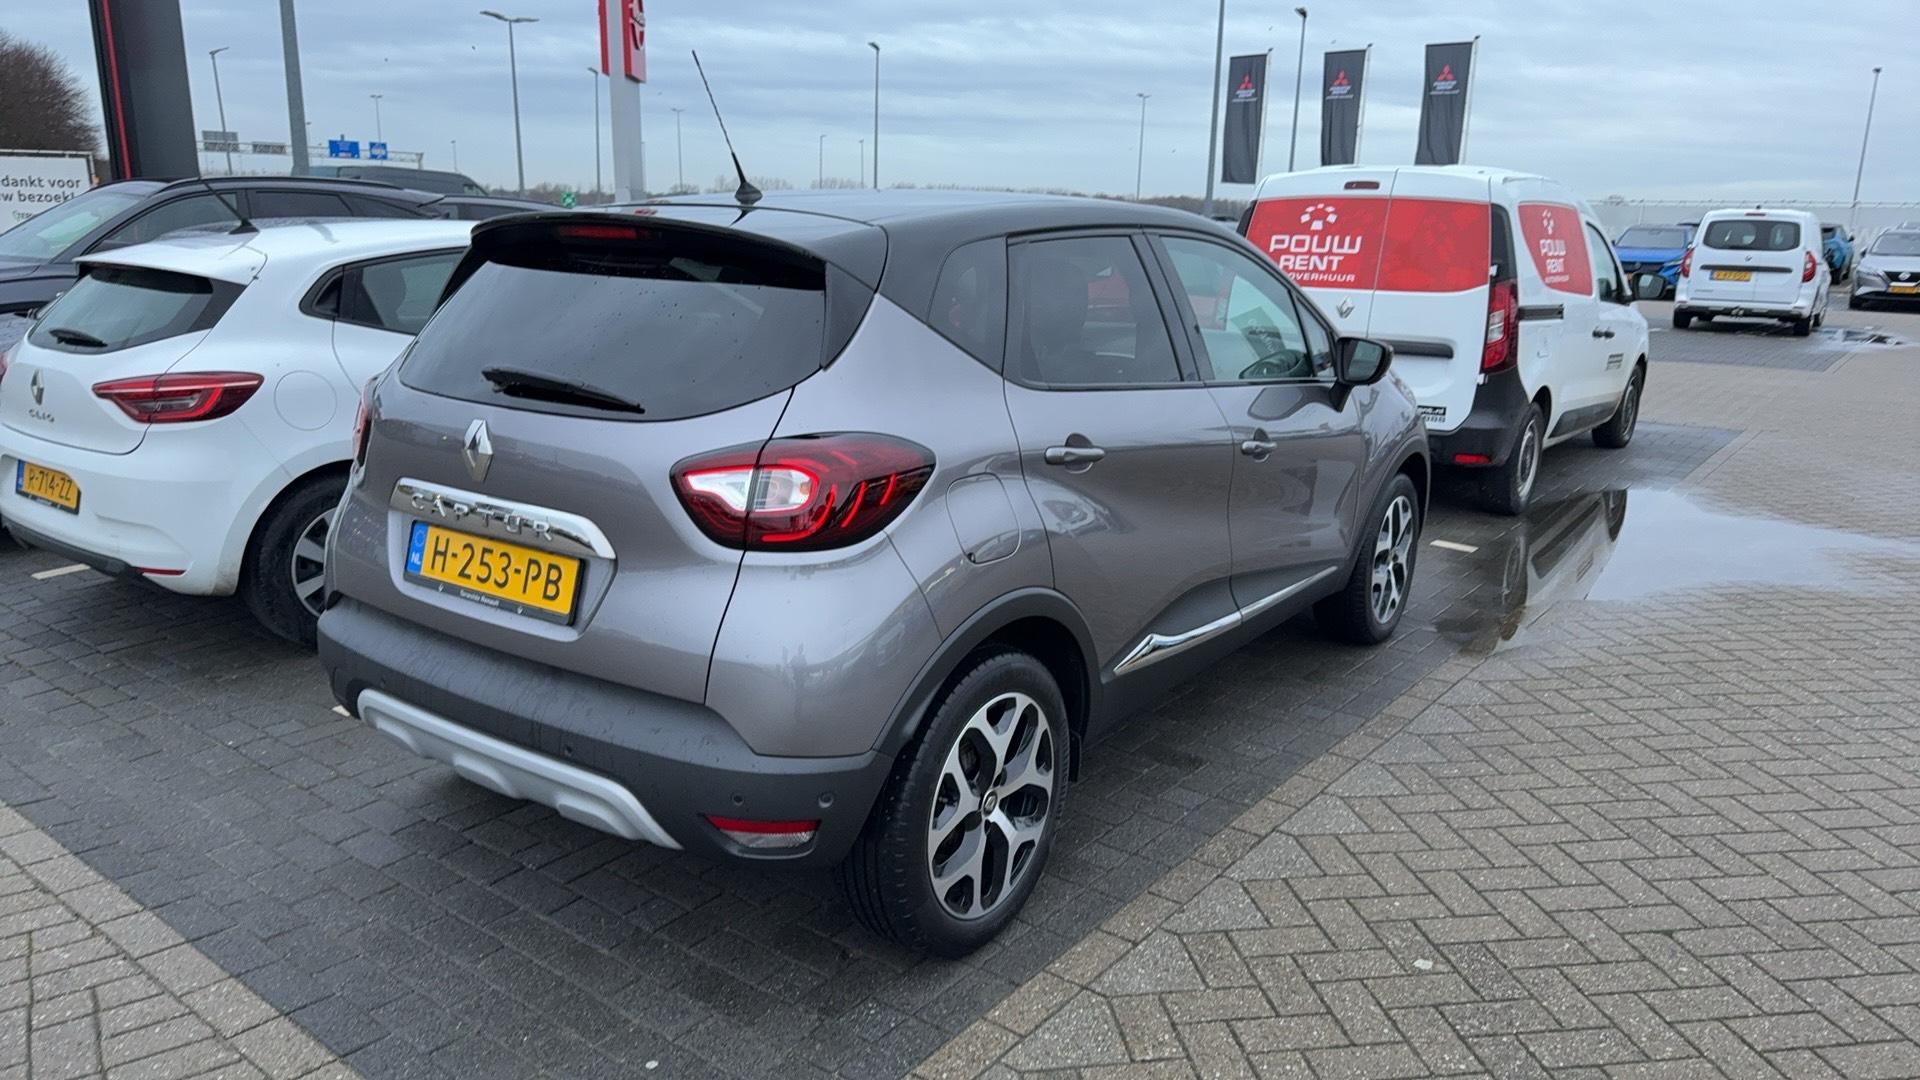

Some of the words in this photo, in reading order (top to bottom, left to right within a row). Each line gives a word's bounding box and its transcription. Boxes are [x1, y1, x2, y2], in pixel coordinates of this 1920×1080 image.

[48, 177, 81, 189] voor
[1269, 234, 1362, 254] POUW
[1539, 239, 1567, 256] POUW
[1279, 254, 1344, 271] RENT
[1546, 258, 1565, 274] RENT
[411, 493, 553, 541] CAPTUR
[410, 551, 421, 566] NL
[431, 536, 562, 600] H-253-PB
